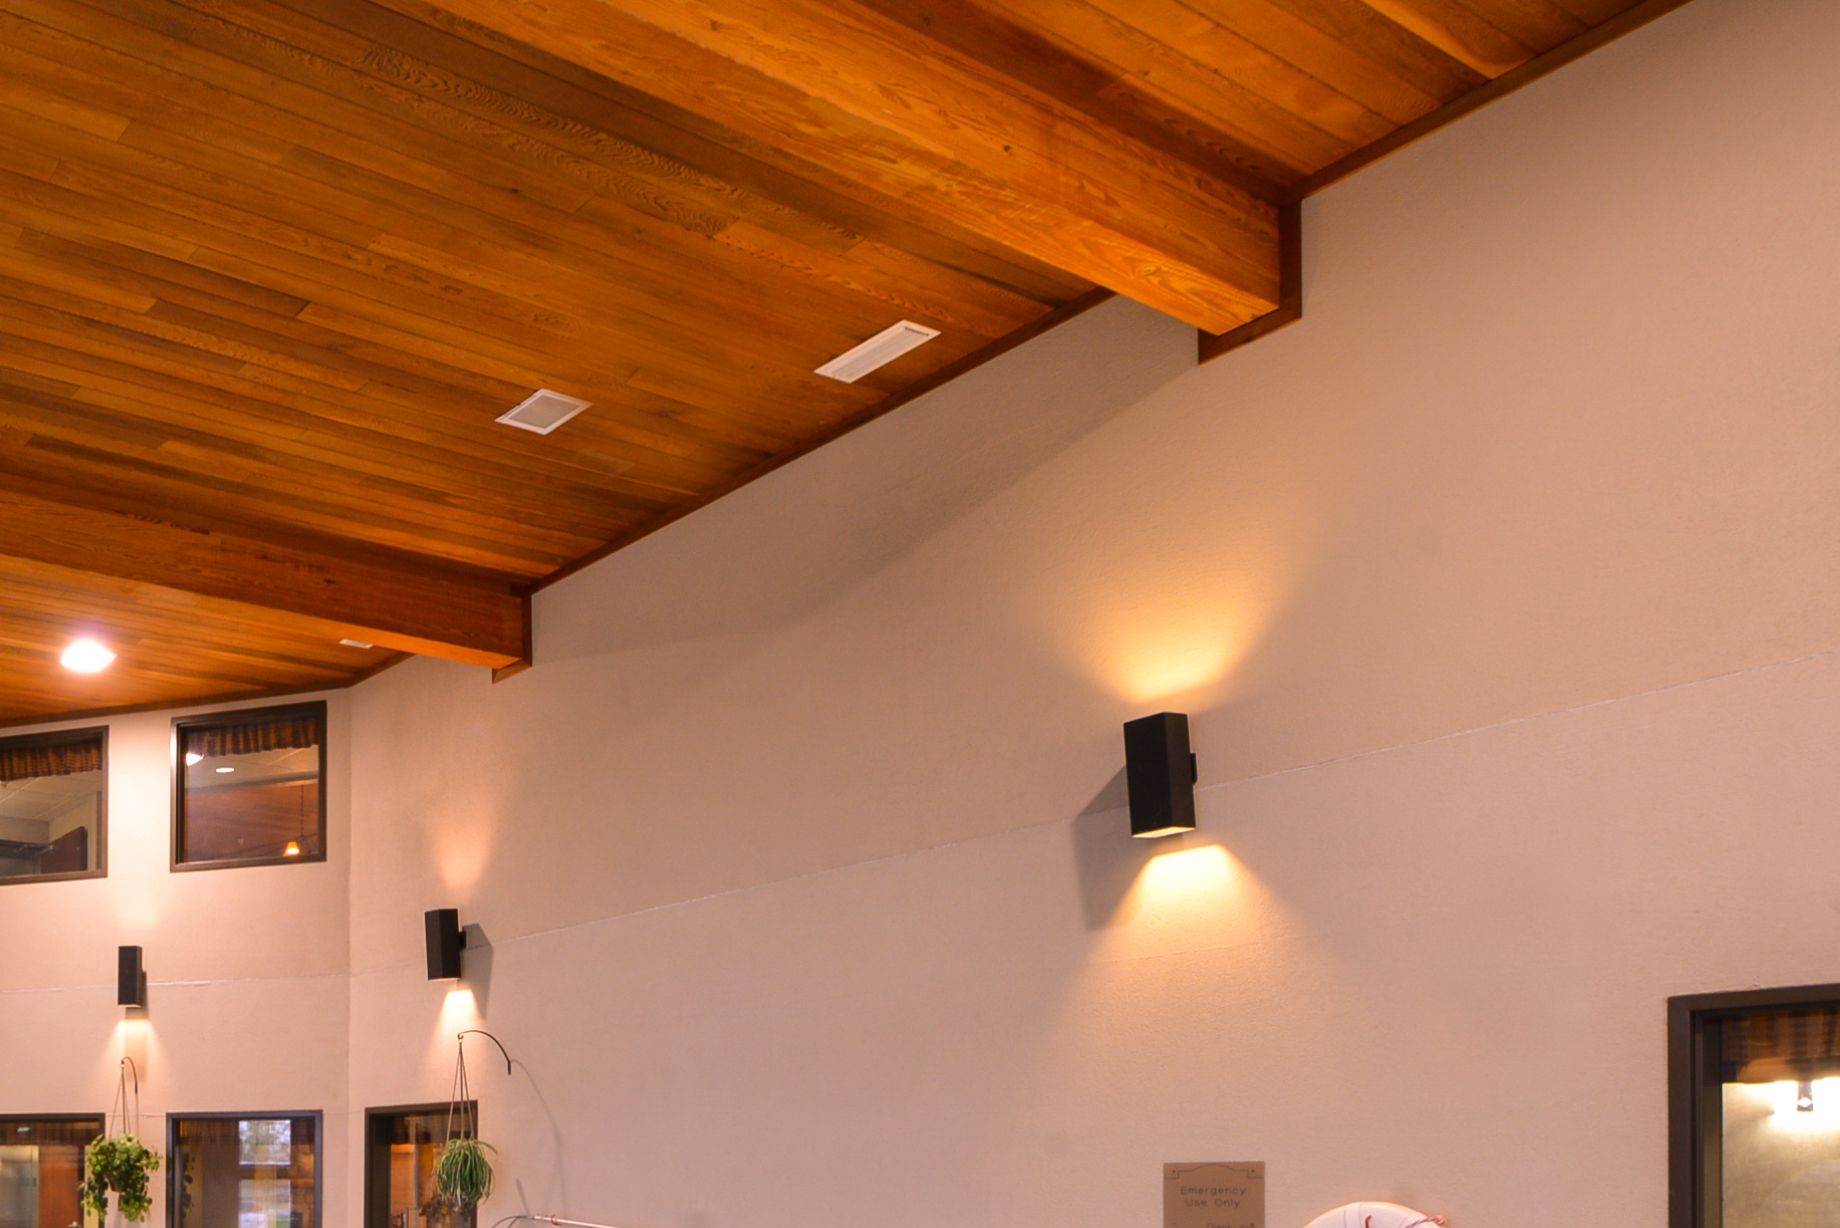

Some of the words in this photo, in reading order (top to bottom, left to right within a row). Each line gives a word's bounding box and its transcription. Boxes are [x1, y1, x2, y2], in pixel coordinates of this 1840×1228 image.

[1180, 1186, 1247, 1197] Emergency
[1185, 1198, 1208, 1208] Use
[1214, 1198, 1240, 1209] Only
